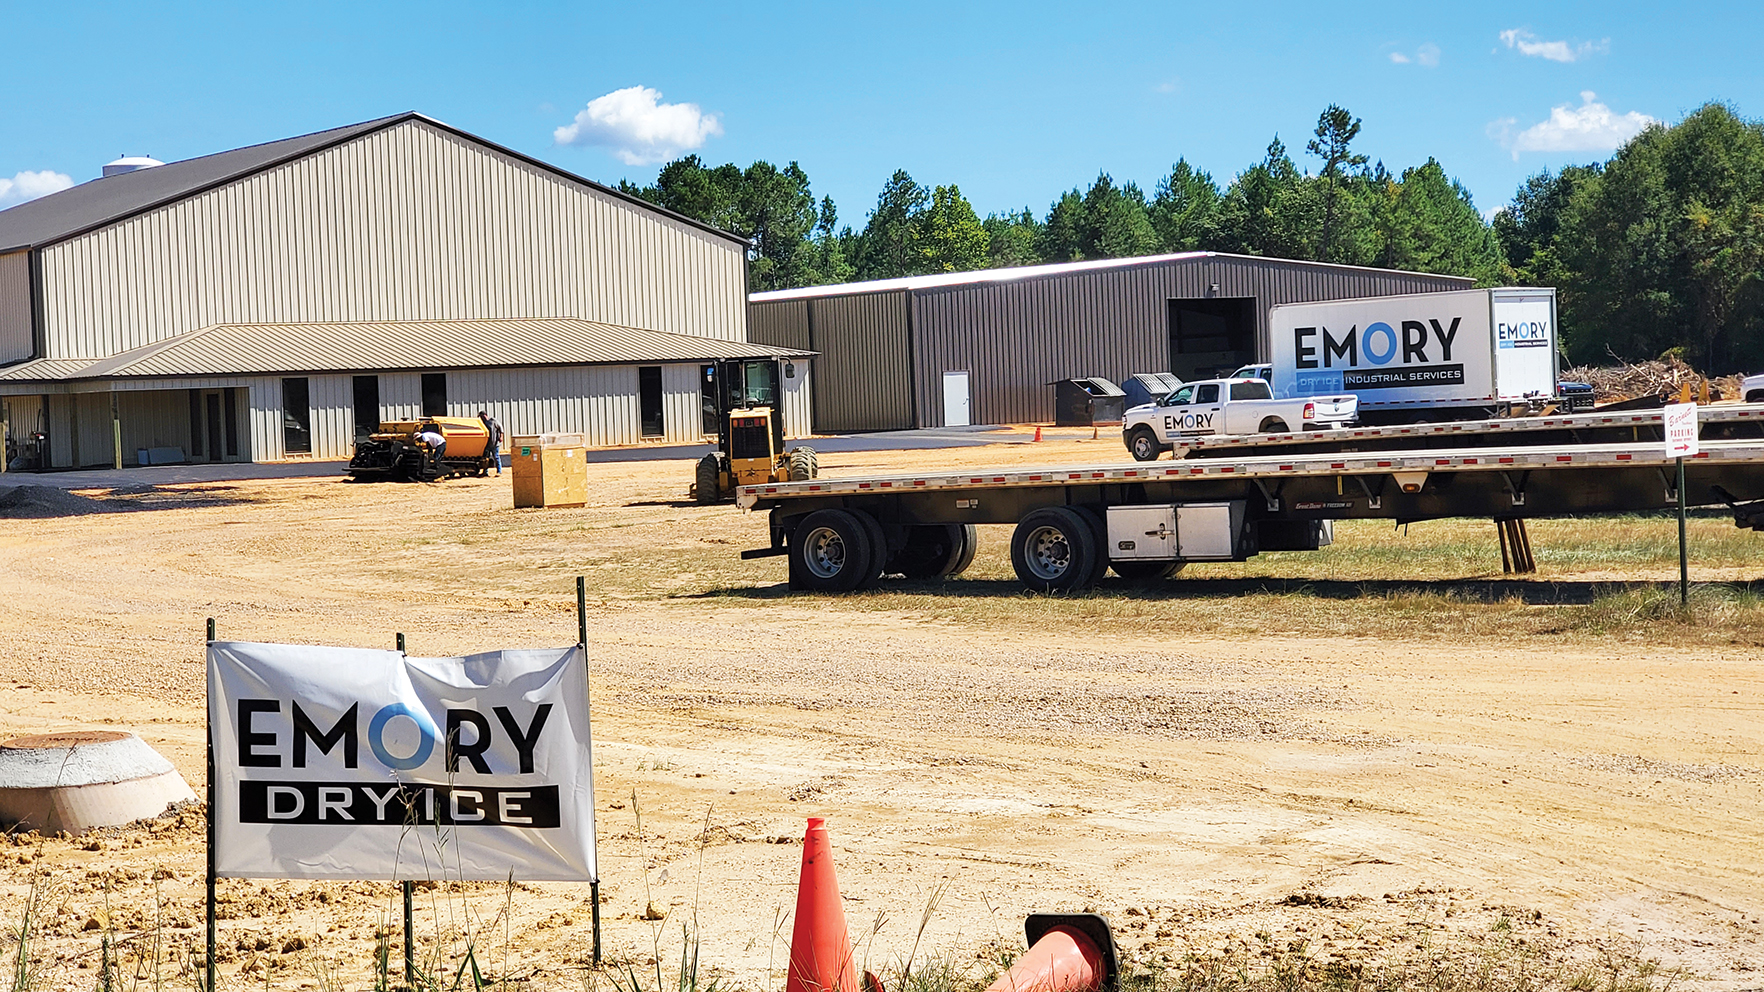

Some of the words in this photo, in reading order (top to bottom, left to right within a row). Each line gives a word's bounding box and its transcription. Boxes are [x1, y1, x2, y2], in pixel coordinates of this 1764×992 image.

[1498, 321, 1547, 339] EMORY
[1294, 317, 1462, 369] EMORY
[1300, 377, 1322, 386] DRY
[1322, 376, 1339, 385] ICE
[1345, 373, 1407, 384] INDUSTRIAL
[1409, 370, 1462, 381] SERVICES
[1164, 413, 1213, 430] EMORY
[1670, 428, 1693, 437] PARKING
[238, 698, 554, 774] EMORY
[266, 785, 400, 821] DRY
[425, 787, 534, 824] ICE
